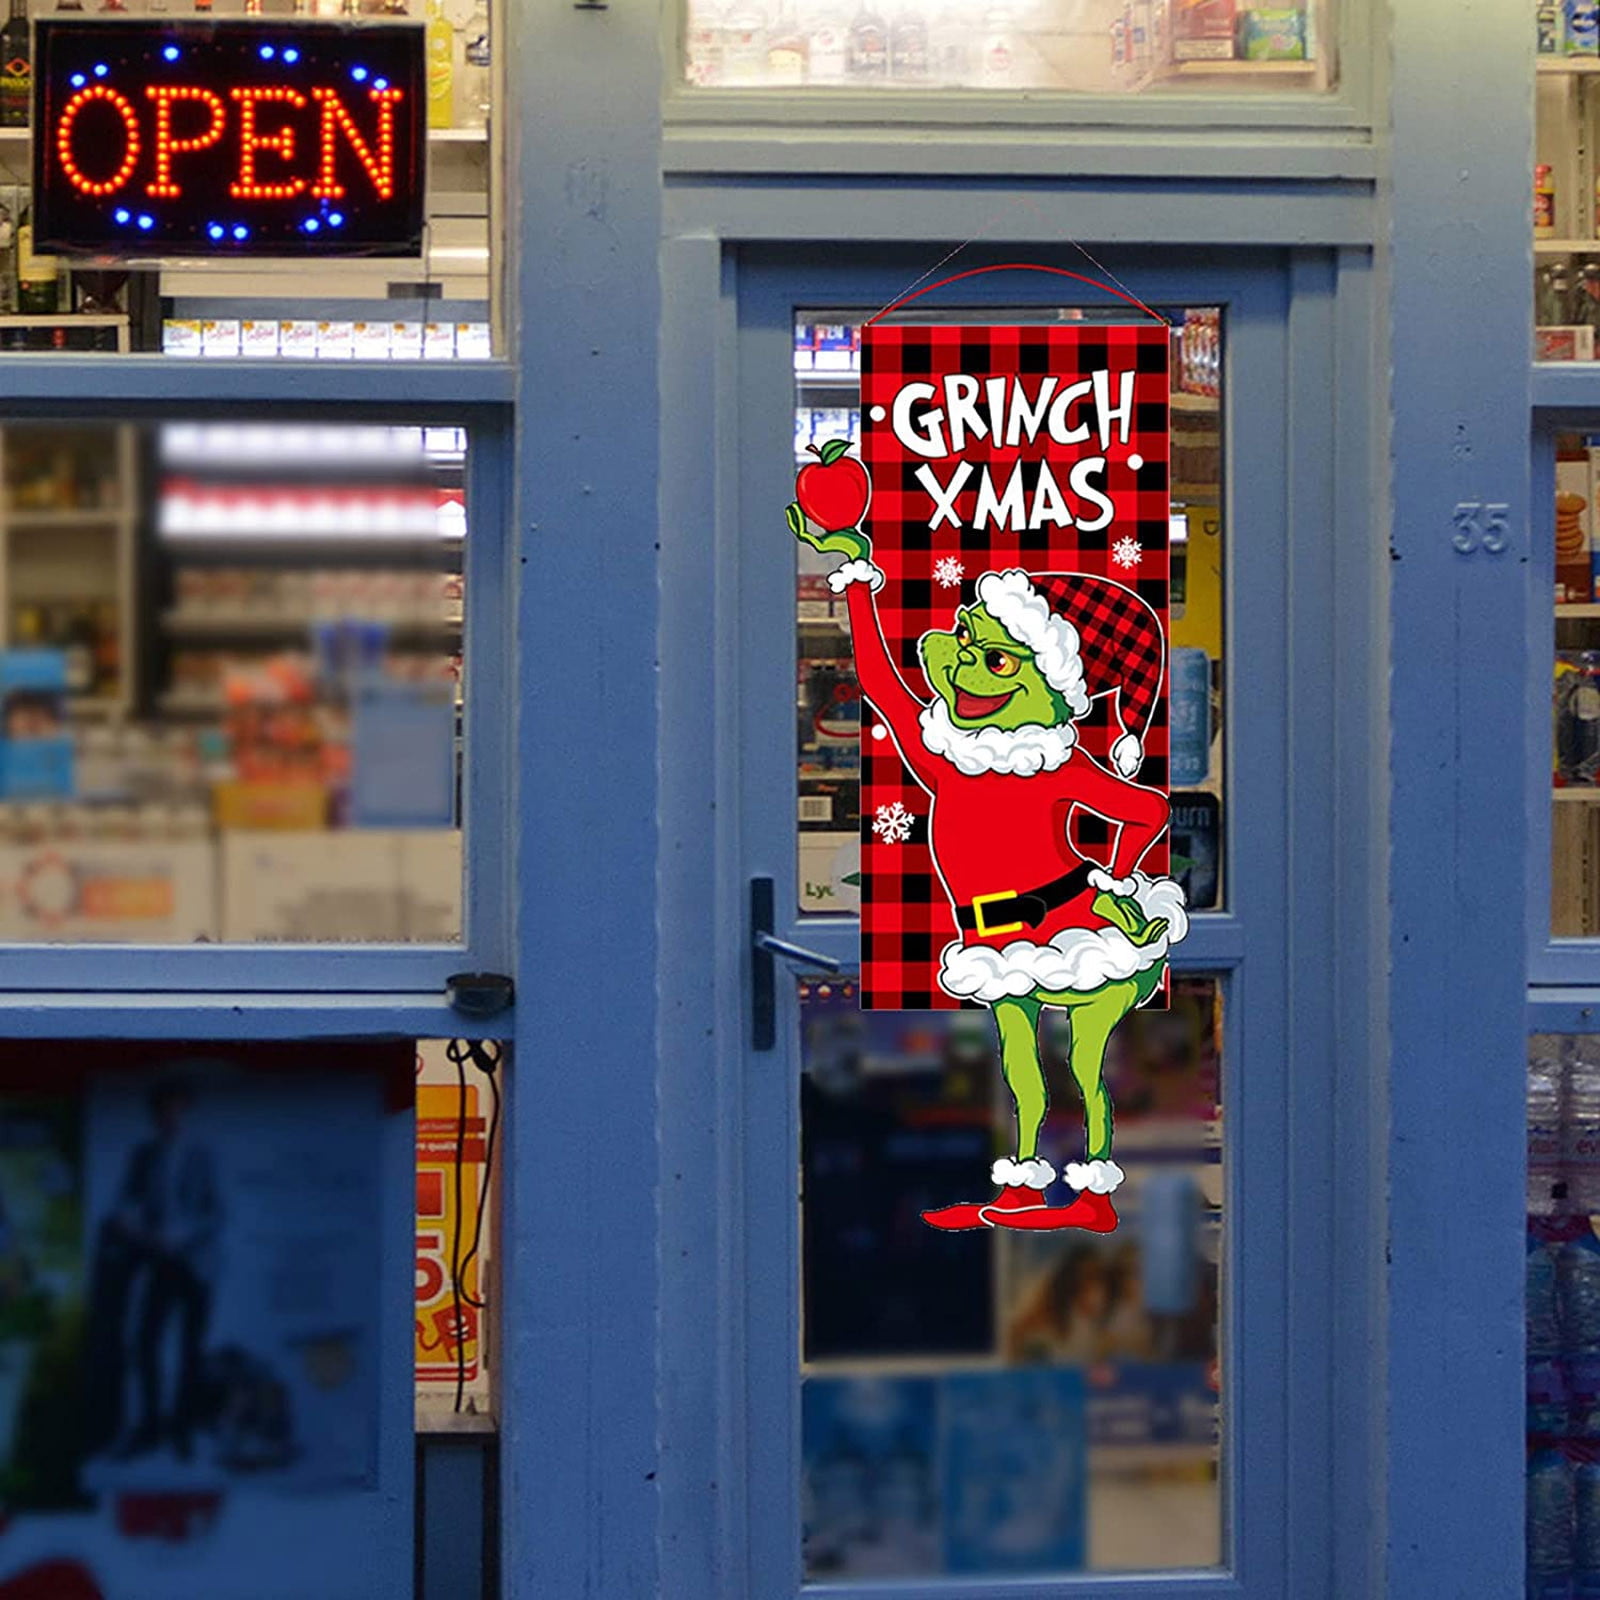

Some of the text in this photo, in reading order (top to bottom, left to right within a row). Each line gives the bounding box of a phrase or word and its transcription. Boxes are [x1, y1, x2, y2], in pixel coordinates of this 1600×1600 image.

[57, 85, 402, 198] OPEN
[891, 368, 1137, 459] GRINCH
[913, 456, 1116, 532] XMAS
[1451, 502, 1511, 555] 35
